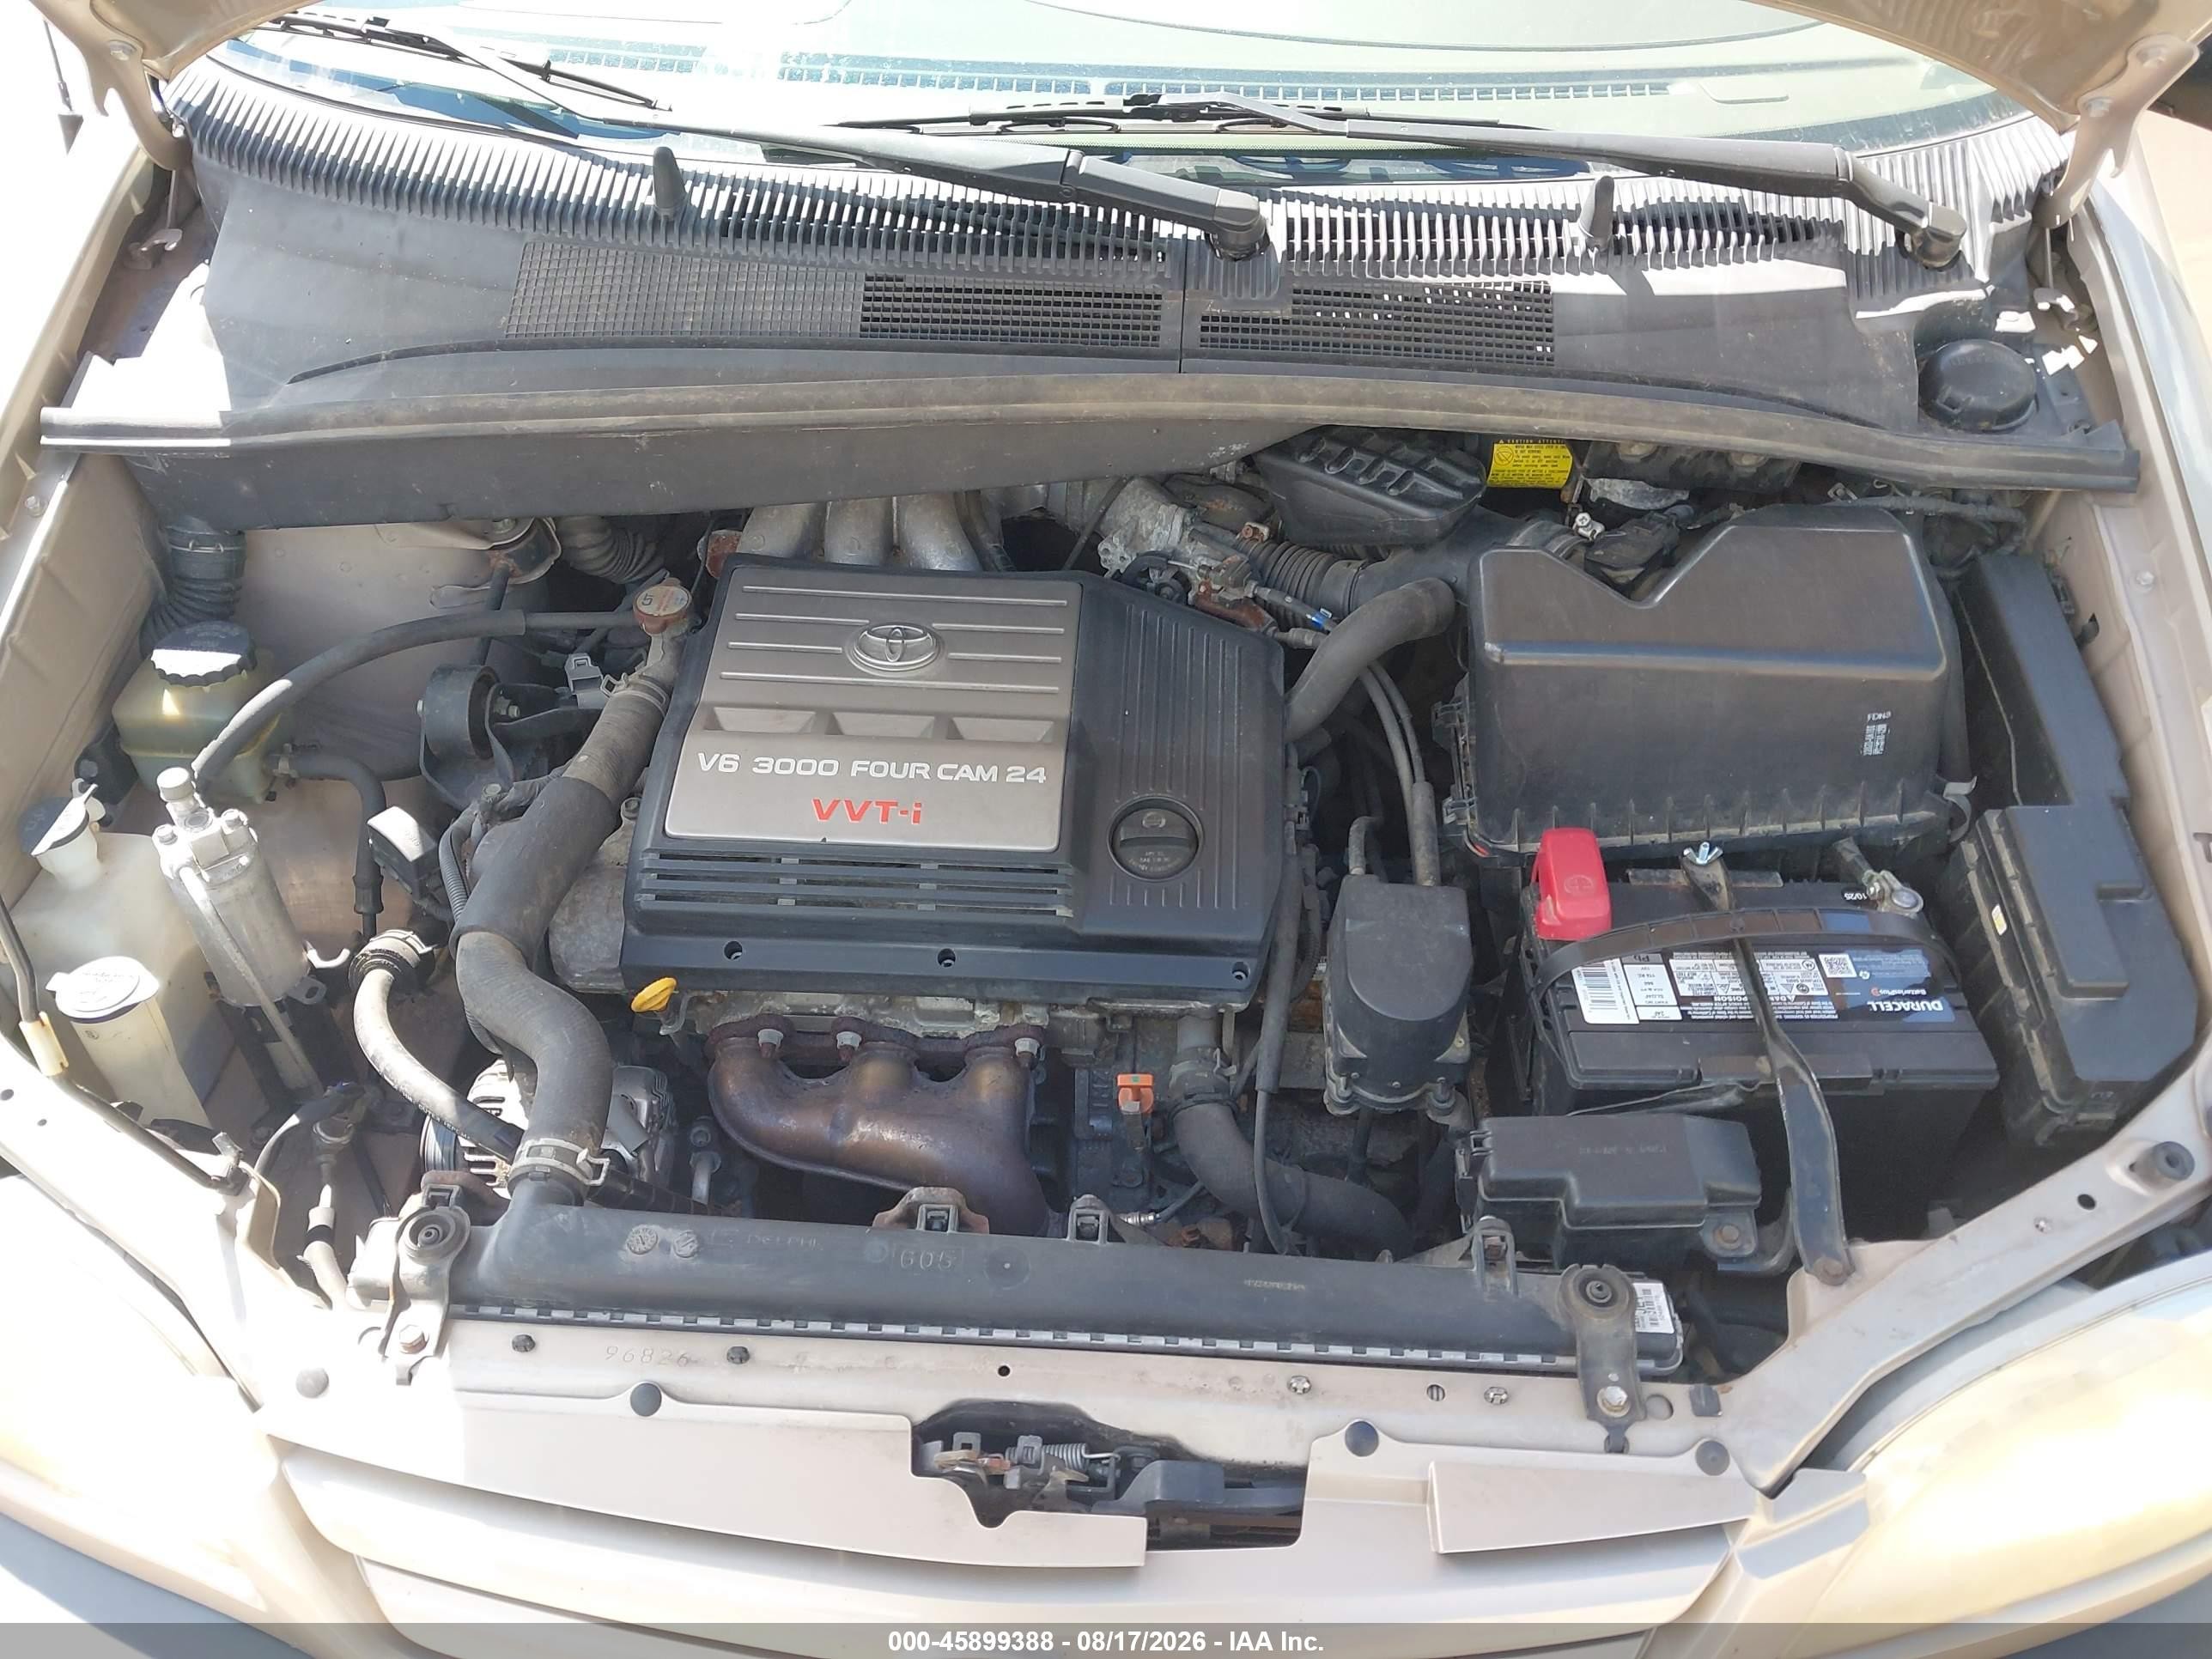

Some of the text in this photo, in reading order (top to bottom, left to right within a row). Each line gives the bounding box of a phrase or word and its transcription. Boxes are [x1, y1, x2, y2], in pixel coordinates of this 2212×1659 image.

[697, 752, 1046, 783] V6 3000 FOUR CAM 24
[811, 797, 923, 824] VVT-i
[1868, 1000, 1944, 1012] DURACELL
